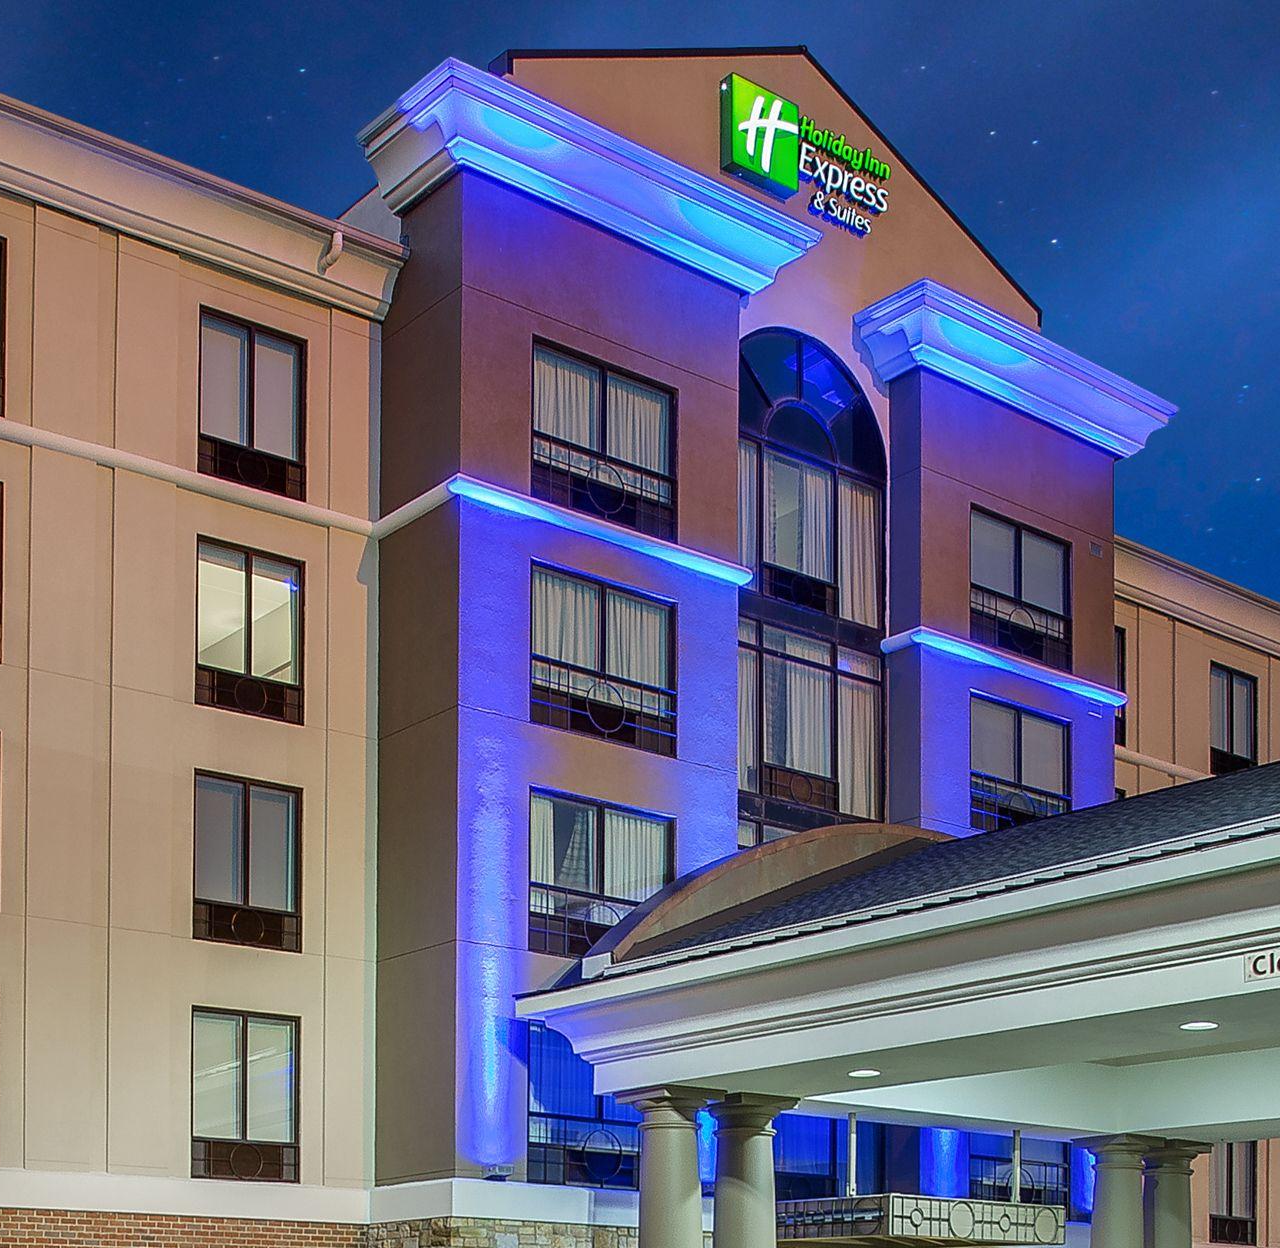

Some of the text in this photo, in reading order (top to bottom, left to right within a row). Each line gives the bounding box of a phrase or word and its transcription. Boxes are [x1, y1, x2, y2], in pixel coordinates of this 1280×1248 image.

[799, 142, 889, 212] Express
[800, 115, 891, 180] Holiday Inn
[813, 191, 872, 234] & Suites
